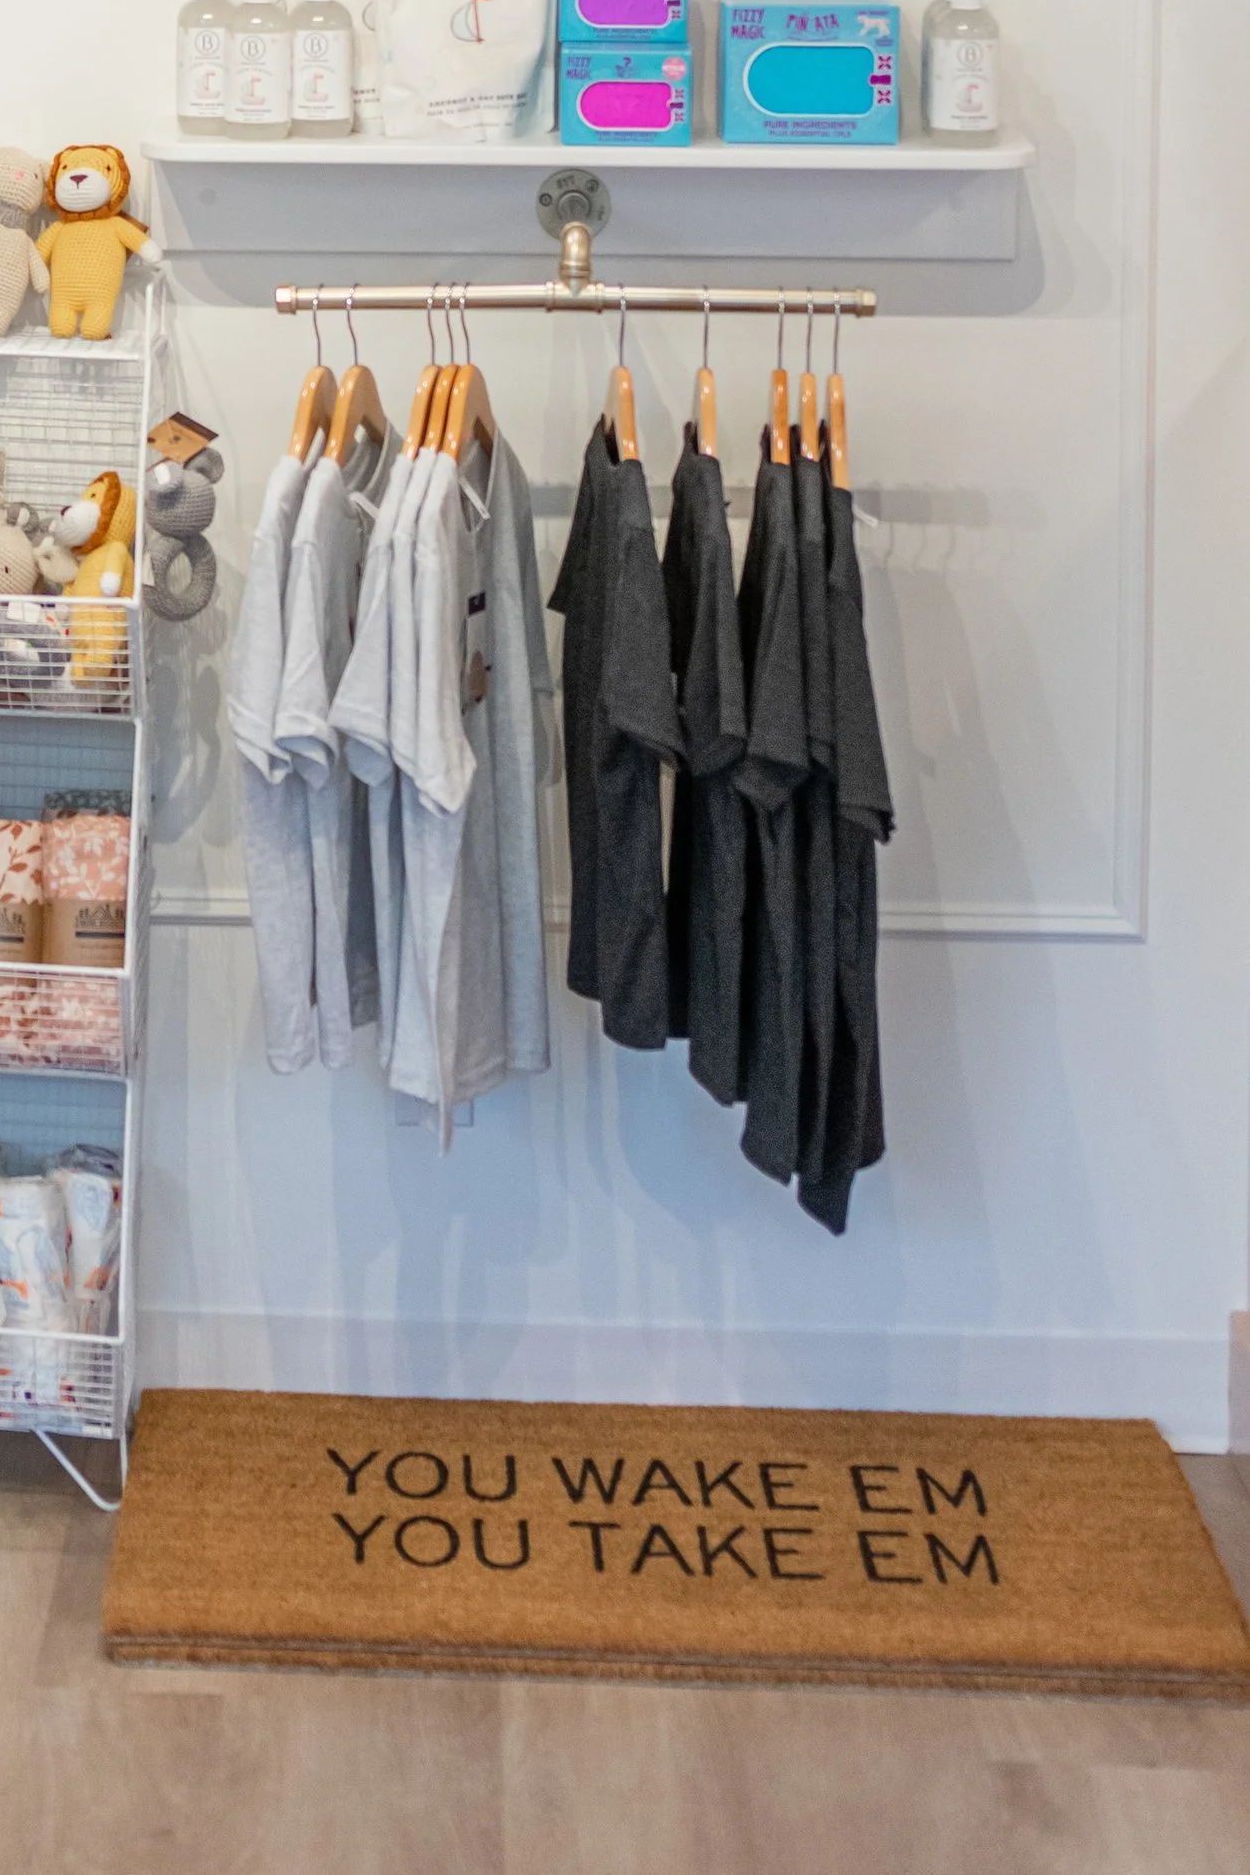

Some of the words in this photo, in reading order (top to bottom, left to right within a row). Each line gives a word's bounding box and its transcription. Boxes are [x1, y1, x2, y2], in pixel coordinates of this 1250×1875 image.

[731, 25, 765, 40] MAGIC
[732, 8, 765, 24] FIZZY
[327, 1449, 517, 1503] YOU
[552, 1457, 820, 1511] WAKE
[850, 1464, 988, 1517] EM
[333, 1513, 530, 1571] YOU
[569, 1521, 824, 1579] TAKE
[856, 1530, 1000, 1585] EM
